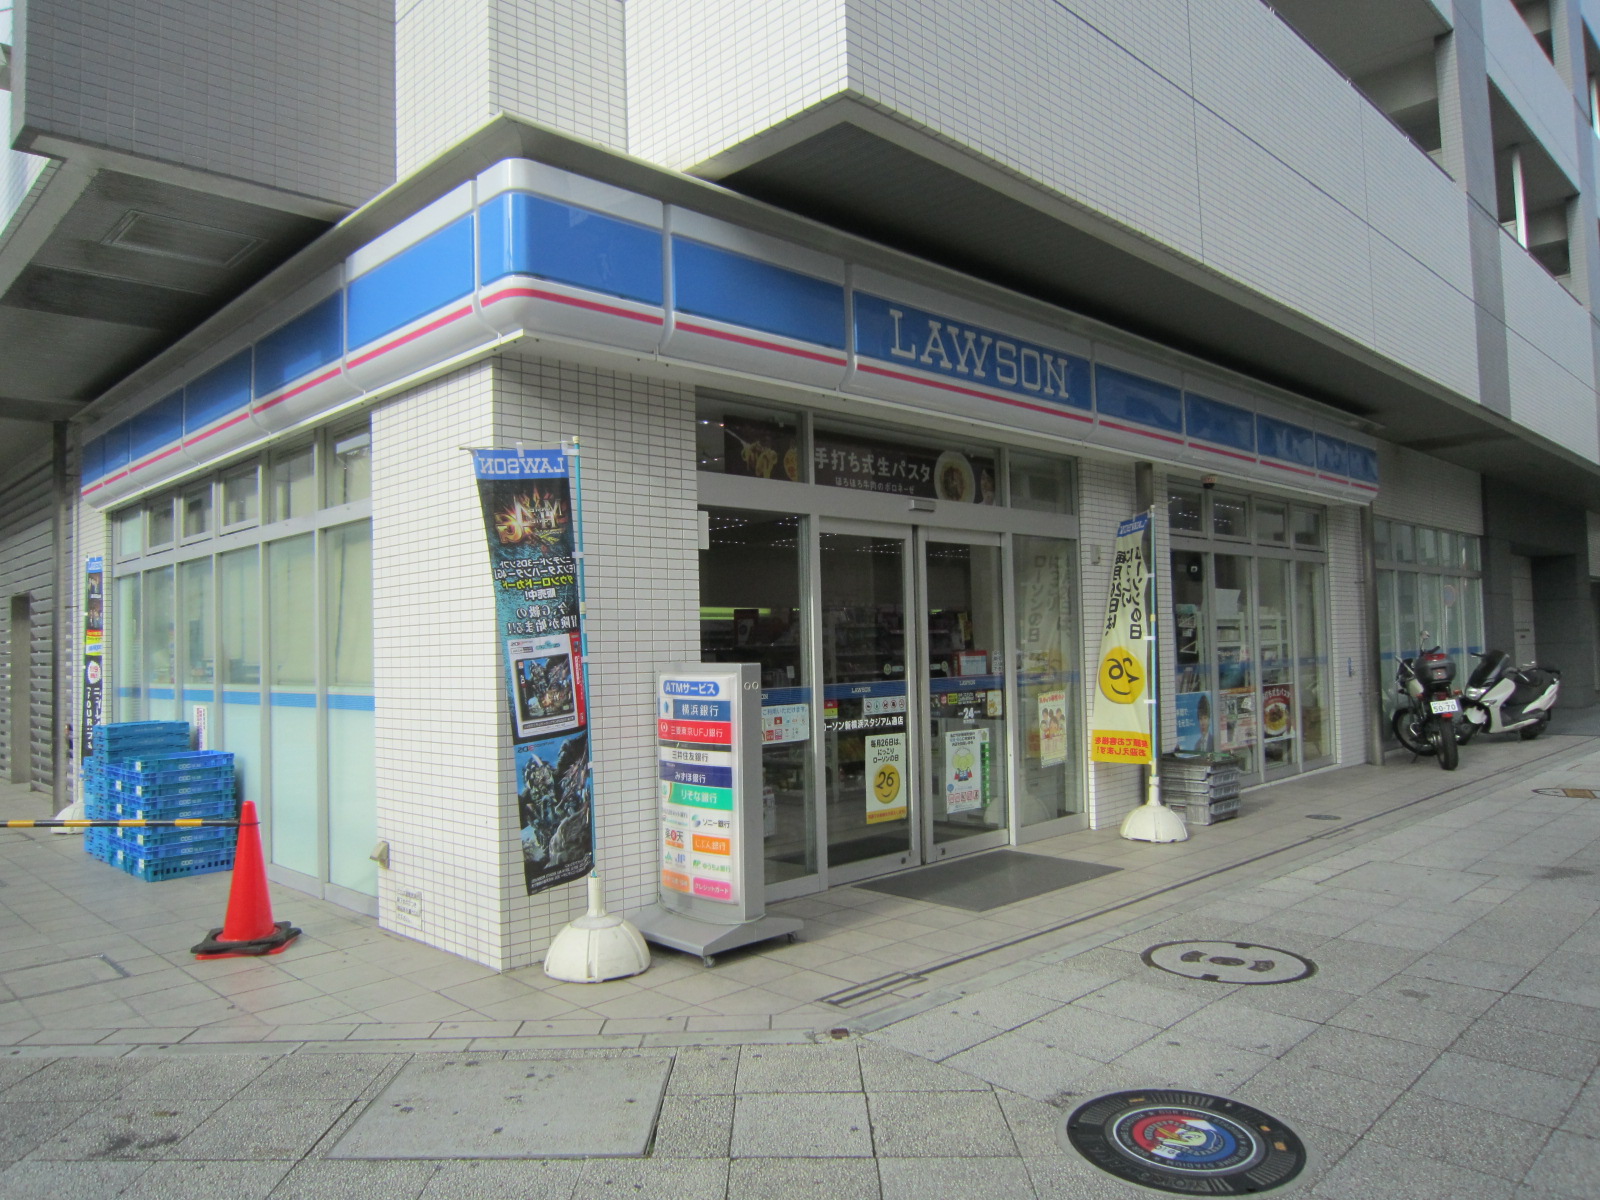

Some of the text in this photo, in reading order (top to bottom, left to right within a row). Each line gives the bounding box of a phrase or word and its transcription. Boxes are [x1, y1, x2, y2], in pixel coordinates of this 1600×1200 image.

[889, 308, 1069, 399] LAWSON
[814, 447, 931, 483] 手打ち式生パスタ
[665, 683, 716, 695] ATMサービス
[681, 703, 719, 717] 横浜銀行
[670, 725, 723, 738] 三菱東京UFJ銀行
[672, 750, 709, 762] 三井住友銀行
[674, 771, 706, 784] みずほ銀行
[681, 789, 718, 804] りそな銀行
[702, 818, 730, 829] ソニー銀行
